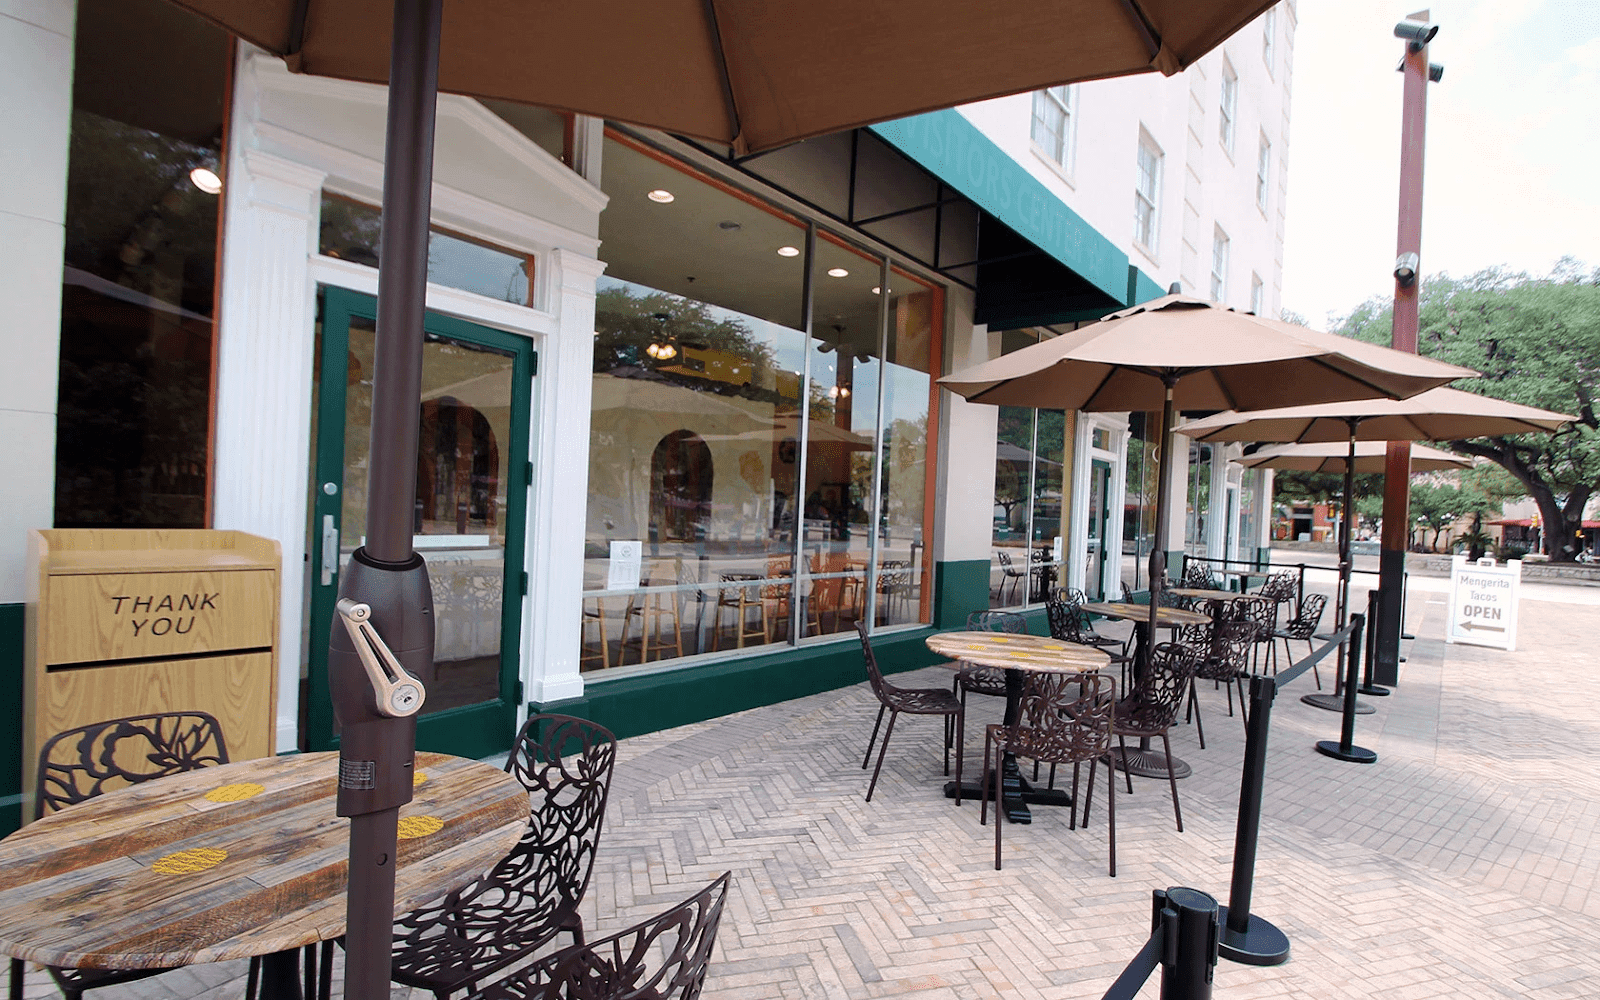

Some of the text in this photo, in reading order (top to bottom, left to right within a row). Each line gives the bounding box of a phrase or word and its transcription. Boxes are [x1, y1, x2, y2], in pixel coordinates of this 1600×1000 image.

[906, 111, 1082, 263] VISITORS CENTER
[1460, 575, 1510, 589] Mengerita
[111, 592, 220, 615] THANK
[1470, 590, 1497, 602] Tacos
[1463, 604, 1502, 620] OPEN
[132, 616, 196, 637] YOU
